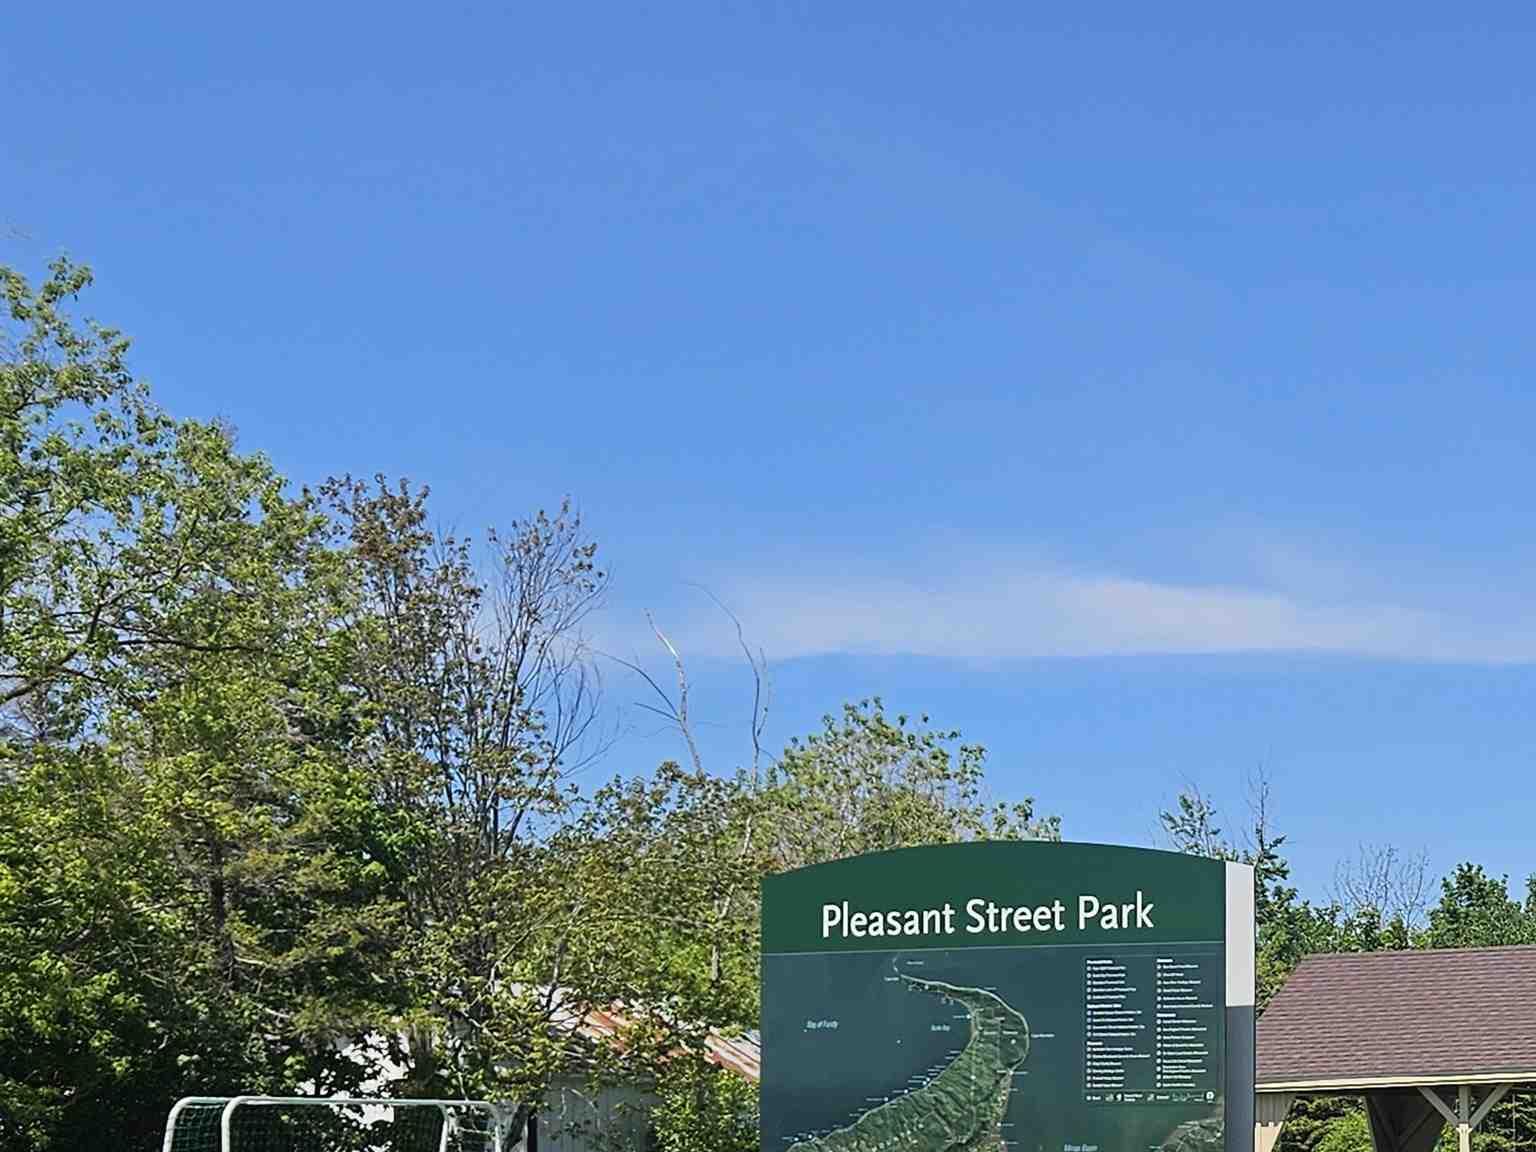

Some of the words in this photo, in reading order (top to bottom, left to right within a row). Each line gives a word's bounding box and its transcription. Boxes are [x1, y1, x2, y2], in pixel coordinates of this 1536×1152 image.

[821, 901, 955, 938] Pleasant
[965, 898, 1065, 934] Street
[1078, 891, 1154, 929] Park
